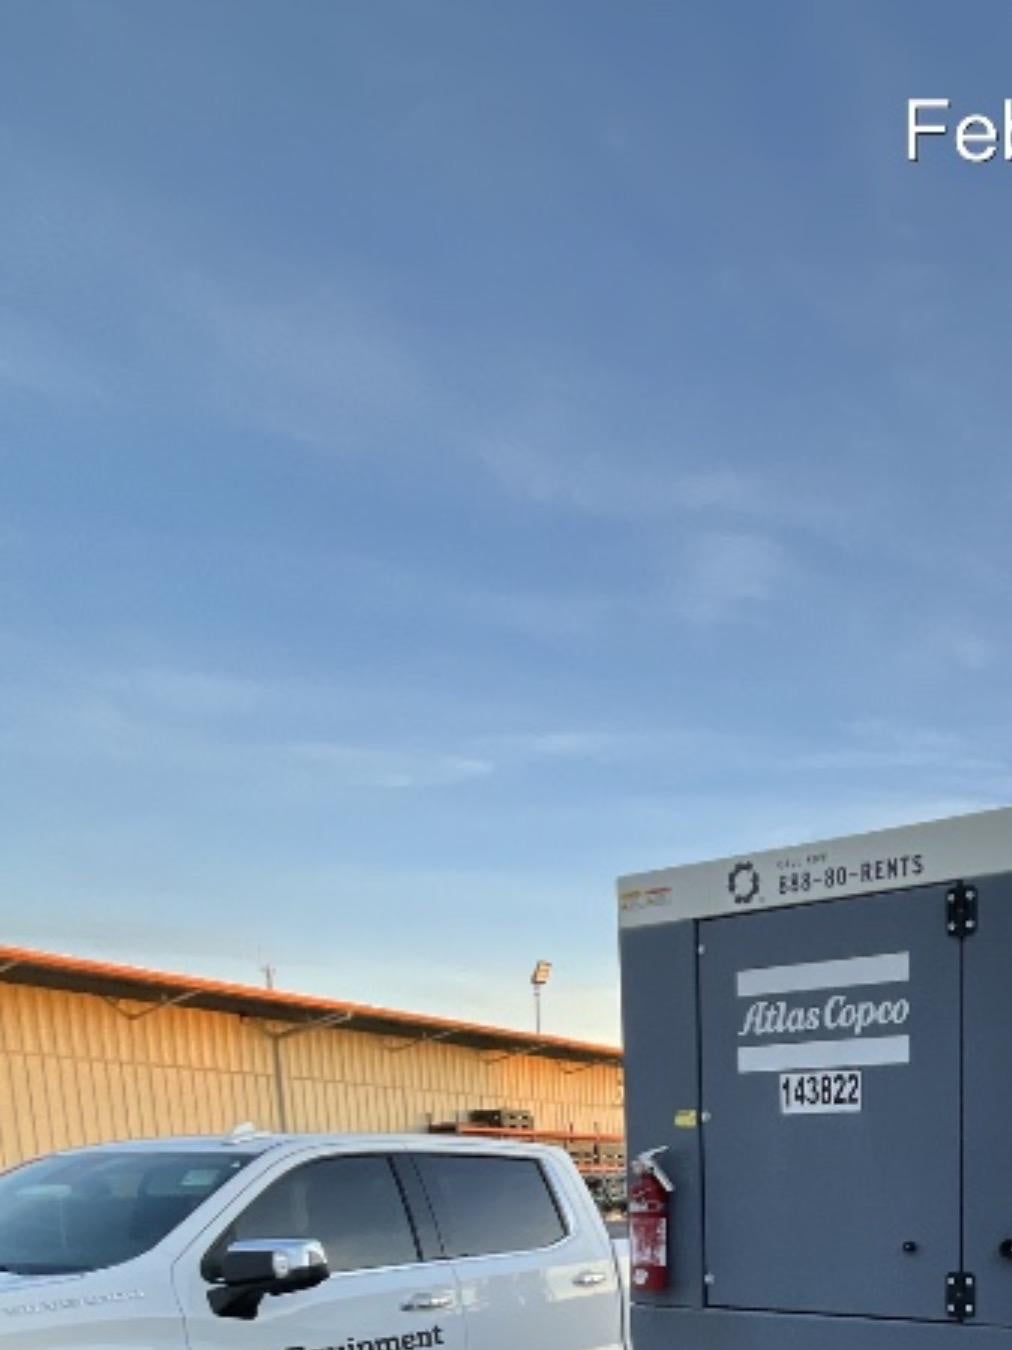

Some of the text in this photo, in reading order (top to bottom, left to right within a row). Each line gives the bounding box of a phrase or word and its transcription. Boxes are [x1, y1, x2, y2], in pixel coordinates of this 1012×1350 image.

[737, 995, 910, 1036] Atlas Copco
[782, 1073, 859, 1106] 143822
